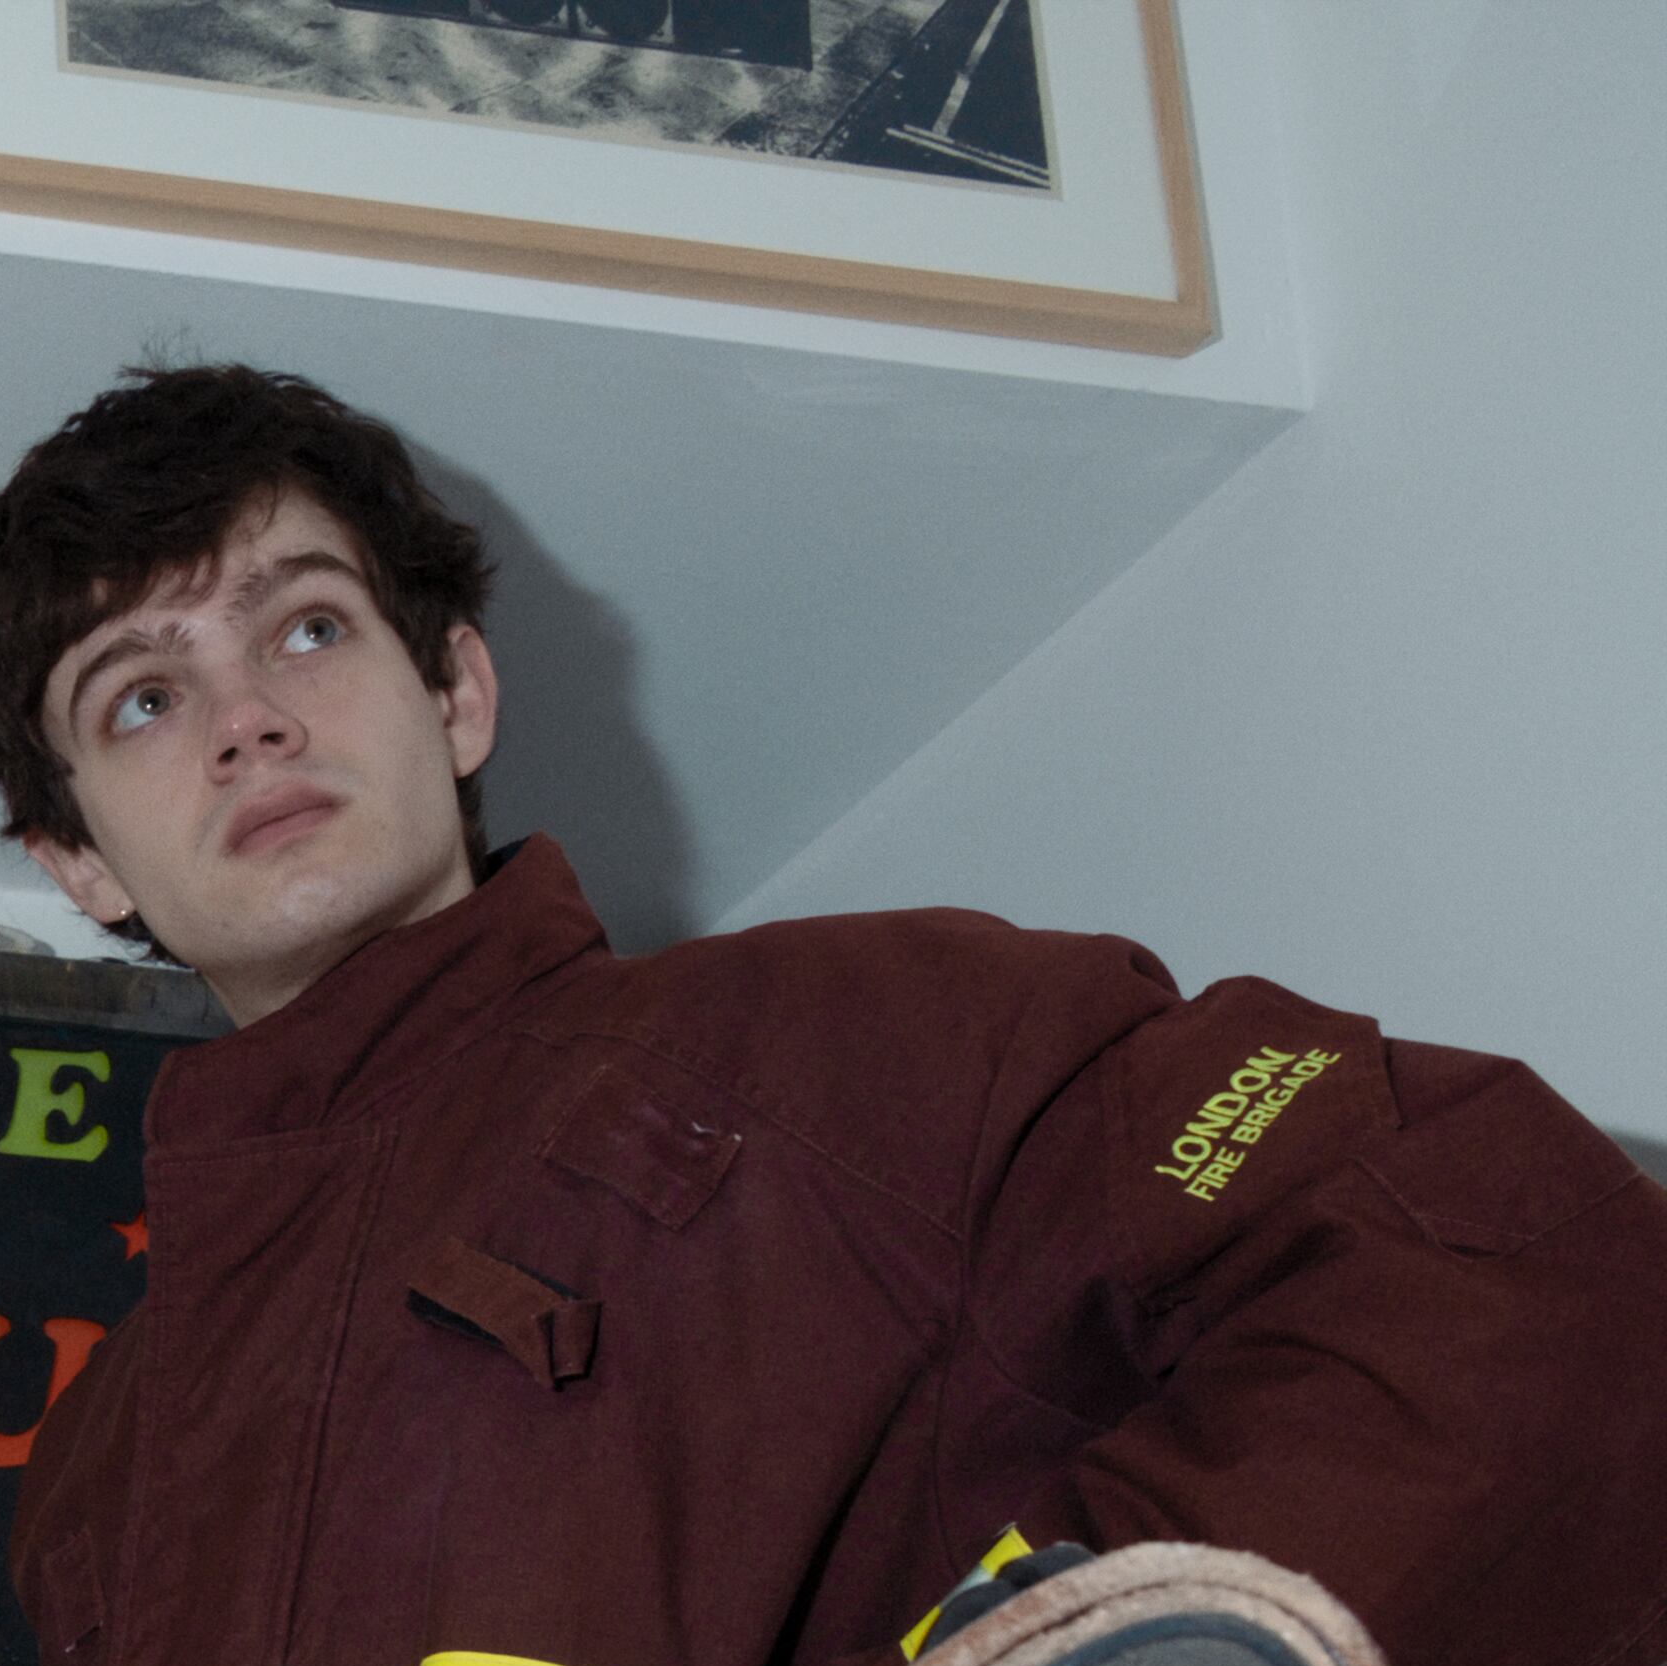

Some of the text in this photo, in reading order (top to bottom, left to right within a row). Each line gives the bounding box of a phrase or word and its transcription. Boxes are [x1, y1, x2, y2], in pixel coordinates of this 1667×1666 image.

[1154, 1045, 1298, 1182] LONDON
[1183, 1048, 1342, 1202] FIRE BRIGADE
